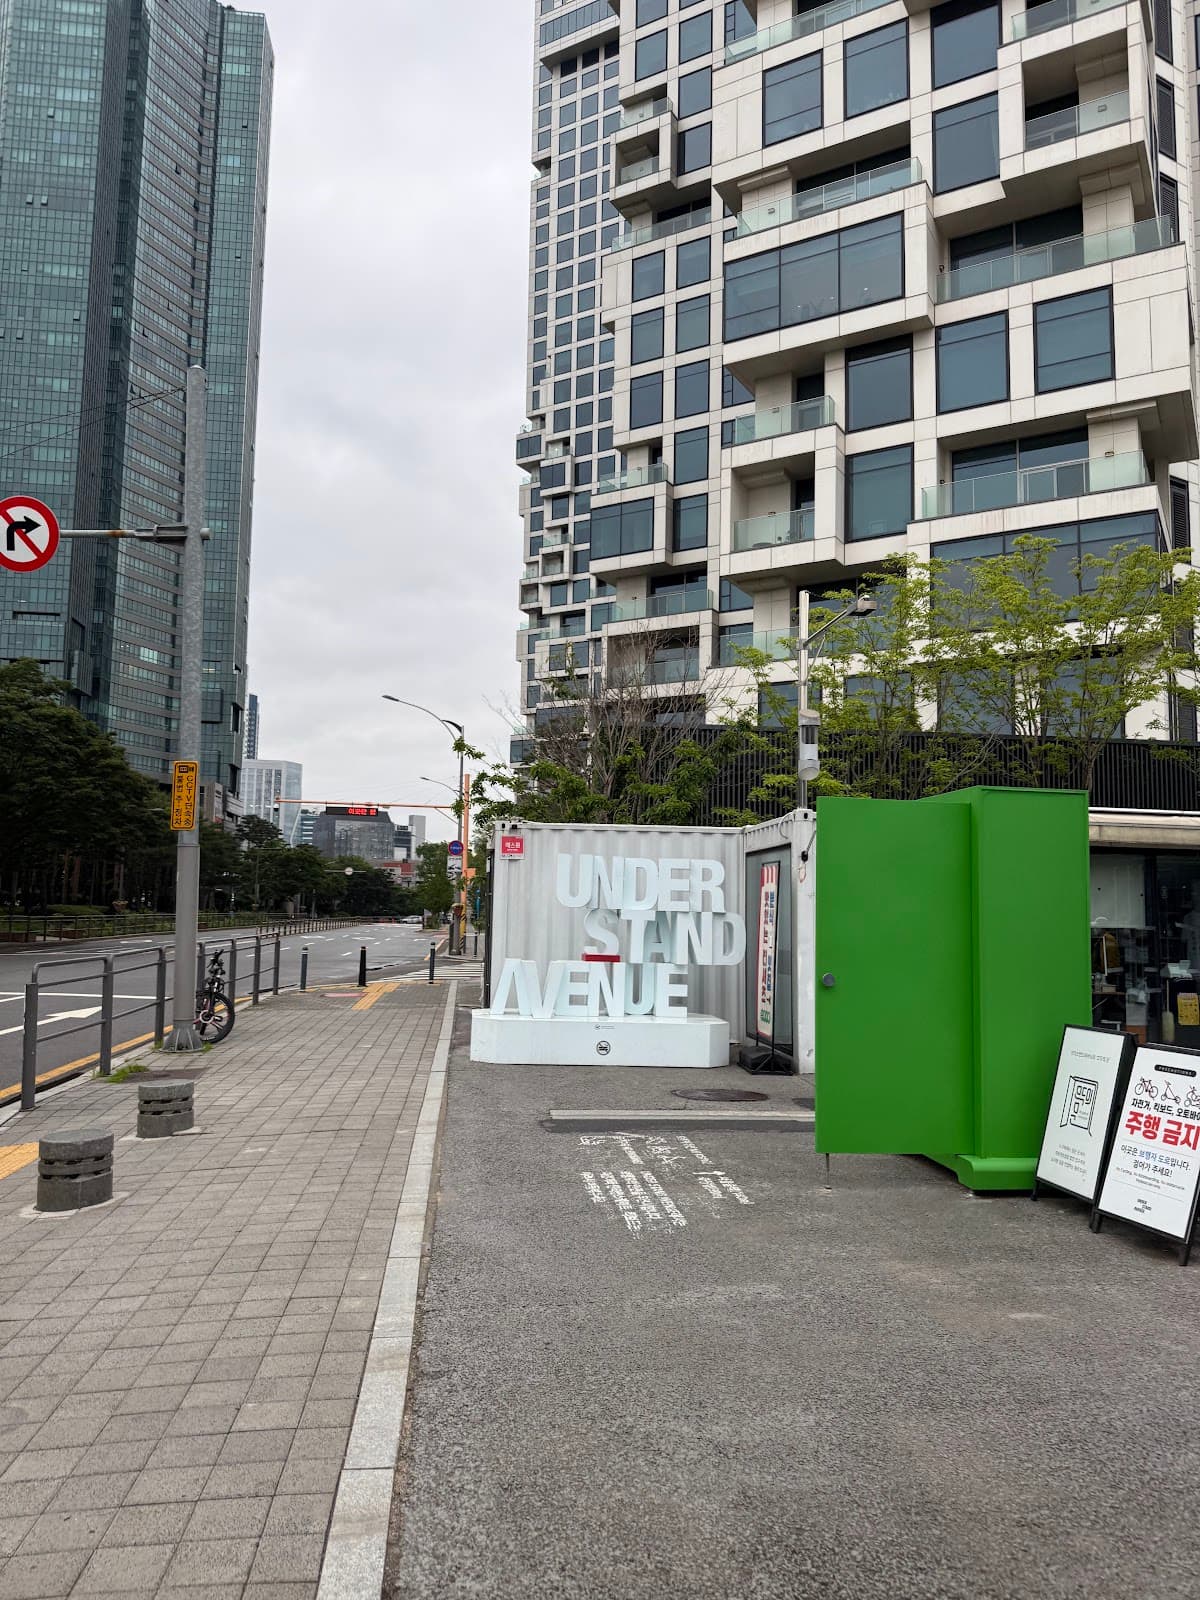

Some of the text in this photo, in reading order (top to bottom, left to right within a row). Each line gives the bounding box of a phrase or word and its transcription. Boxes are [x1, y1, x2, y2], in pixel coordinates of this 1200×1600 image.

[556, 853, 725, 913] UNDER
[584, 909, 746, 966] STAND
[490, 959, 689, 1019] AVENUE
[1125, 1111, 1200, 1151] 주행 금지
